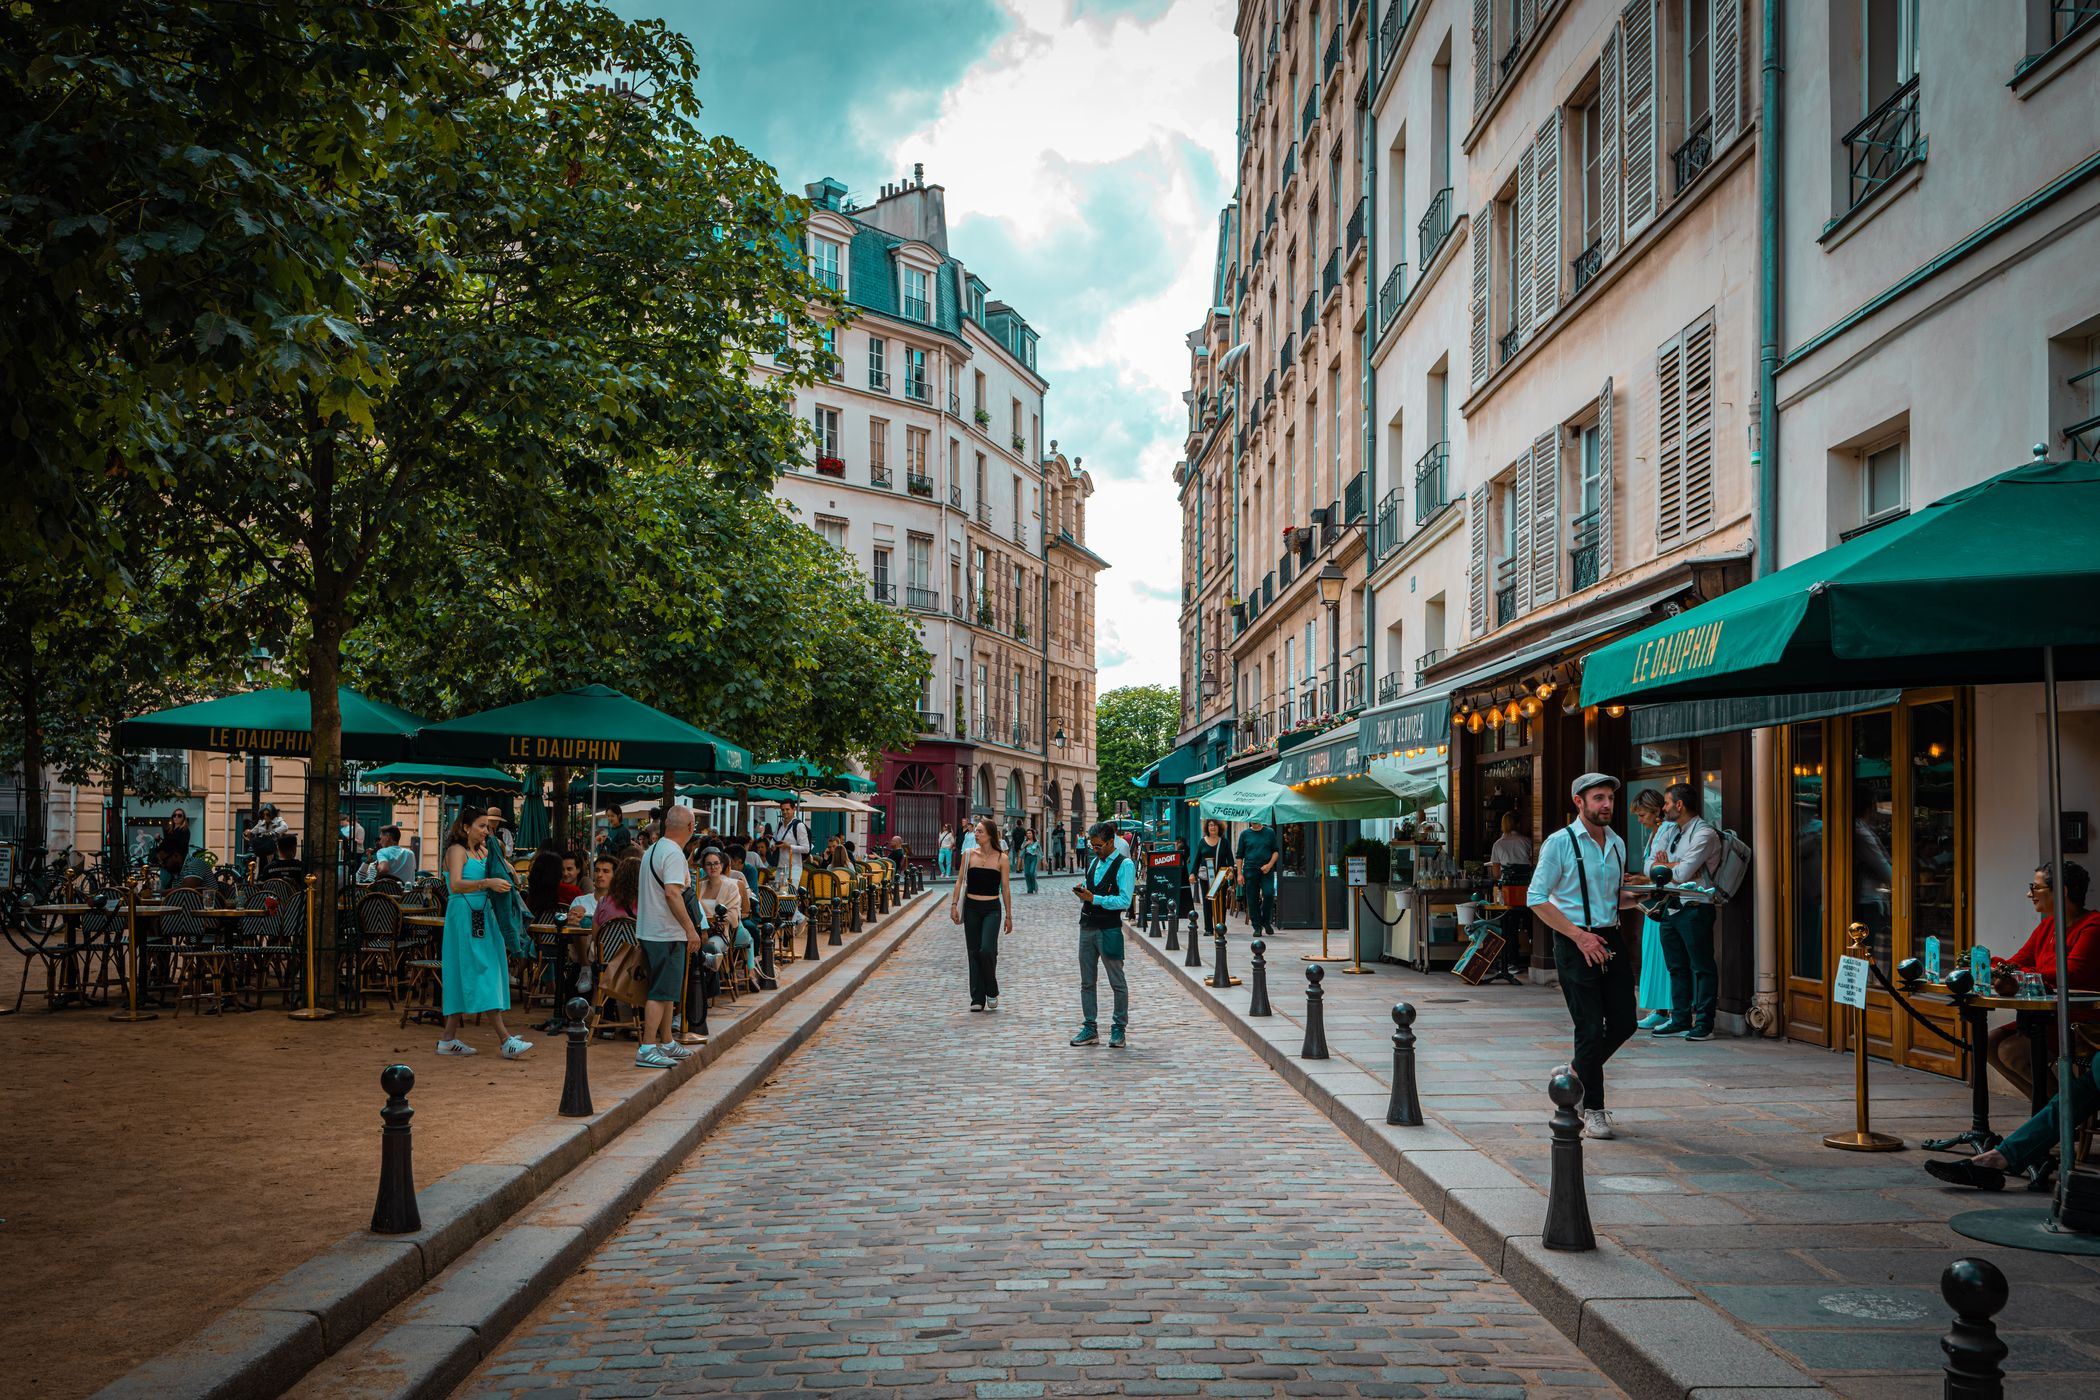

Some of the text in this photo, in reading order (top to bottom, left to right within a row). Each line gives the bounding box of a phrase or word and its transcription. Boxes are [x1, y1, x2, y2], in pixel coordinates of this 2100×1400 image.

[1632, 620, 1723, 684] LE DAUPHIN
[209, 727, 230, 747] LE
[510, 736, 620, 761] LE DAUPHIN
[750, 773, 817, 788] BRASSIE
